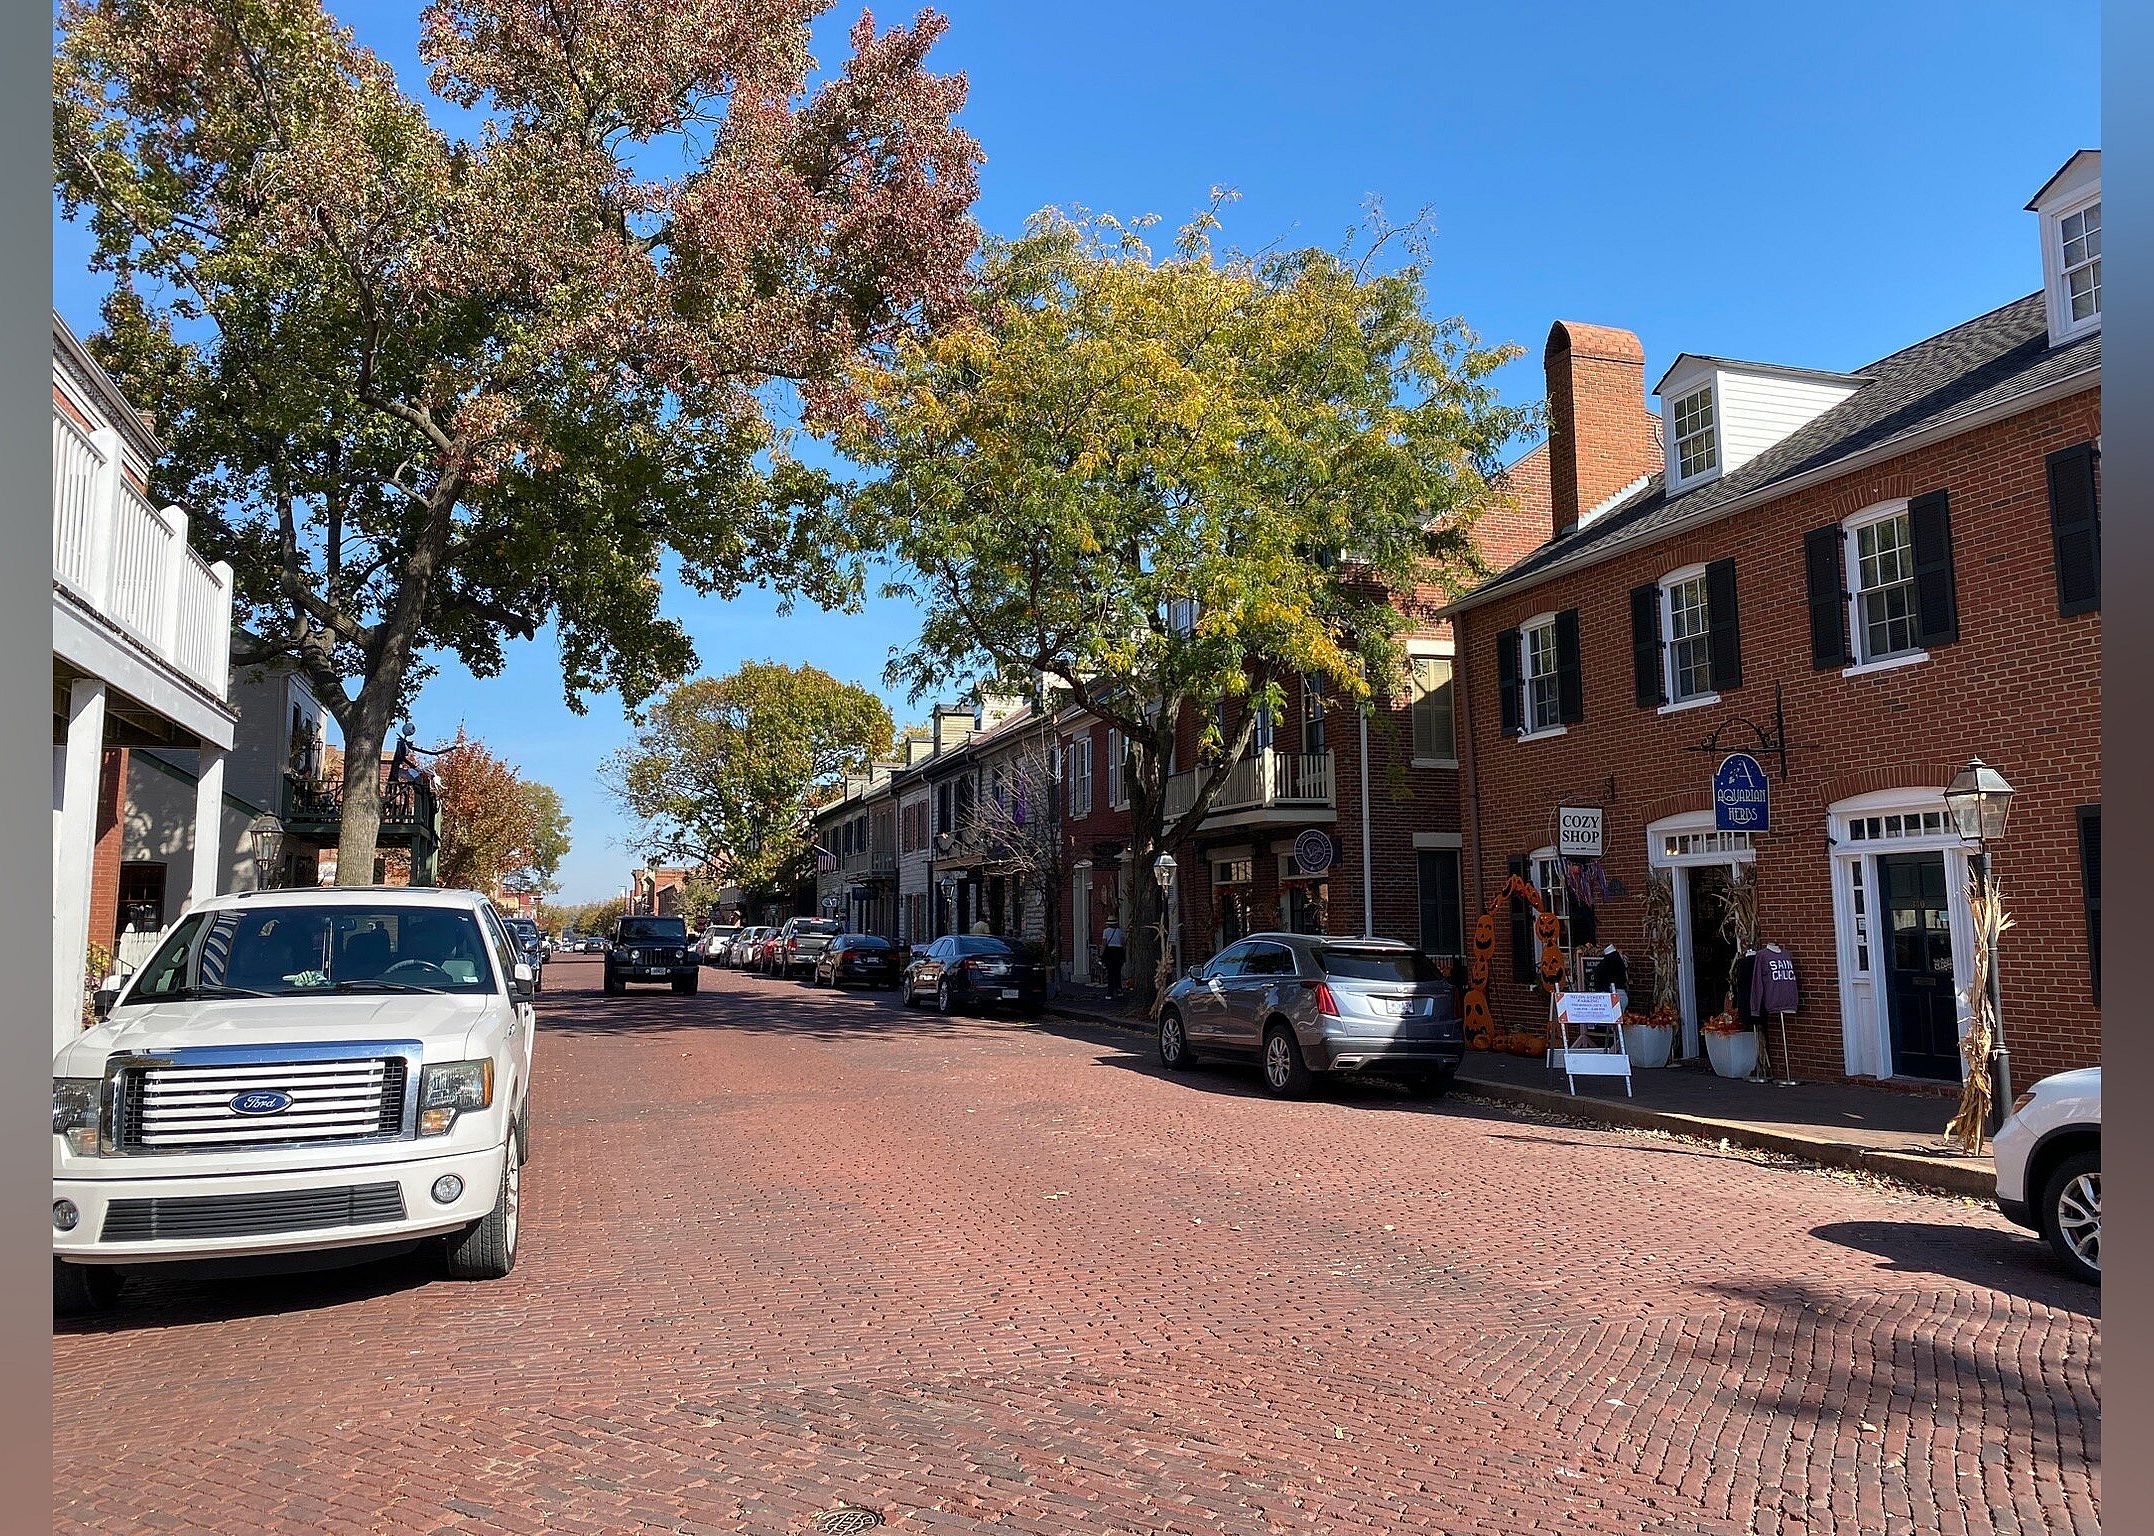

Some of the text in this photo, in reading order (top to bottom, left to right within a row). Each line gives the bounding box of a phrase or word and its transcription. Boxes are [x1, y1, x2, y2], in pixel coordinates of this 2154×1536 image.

[1717, 788, 1767, 806] AQUARIAN
[1562, 815, 1600, 828] COZY
[1728, 807, 1758, 825] HERBS
[1562, 830, 1600, 843] SHOP
[243, 1095, 277, 1108] Ford
